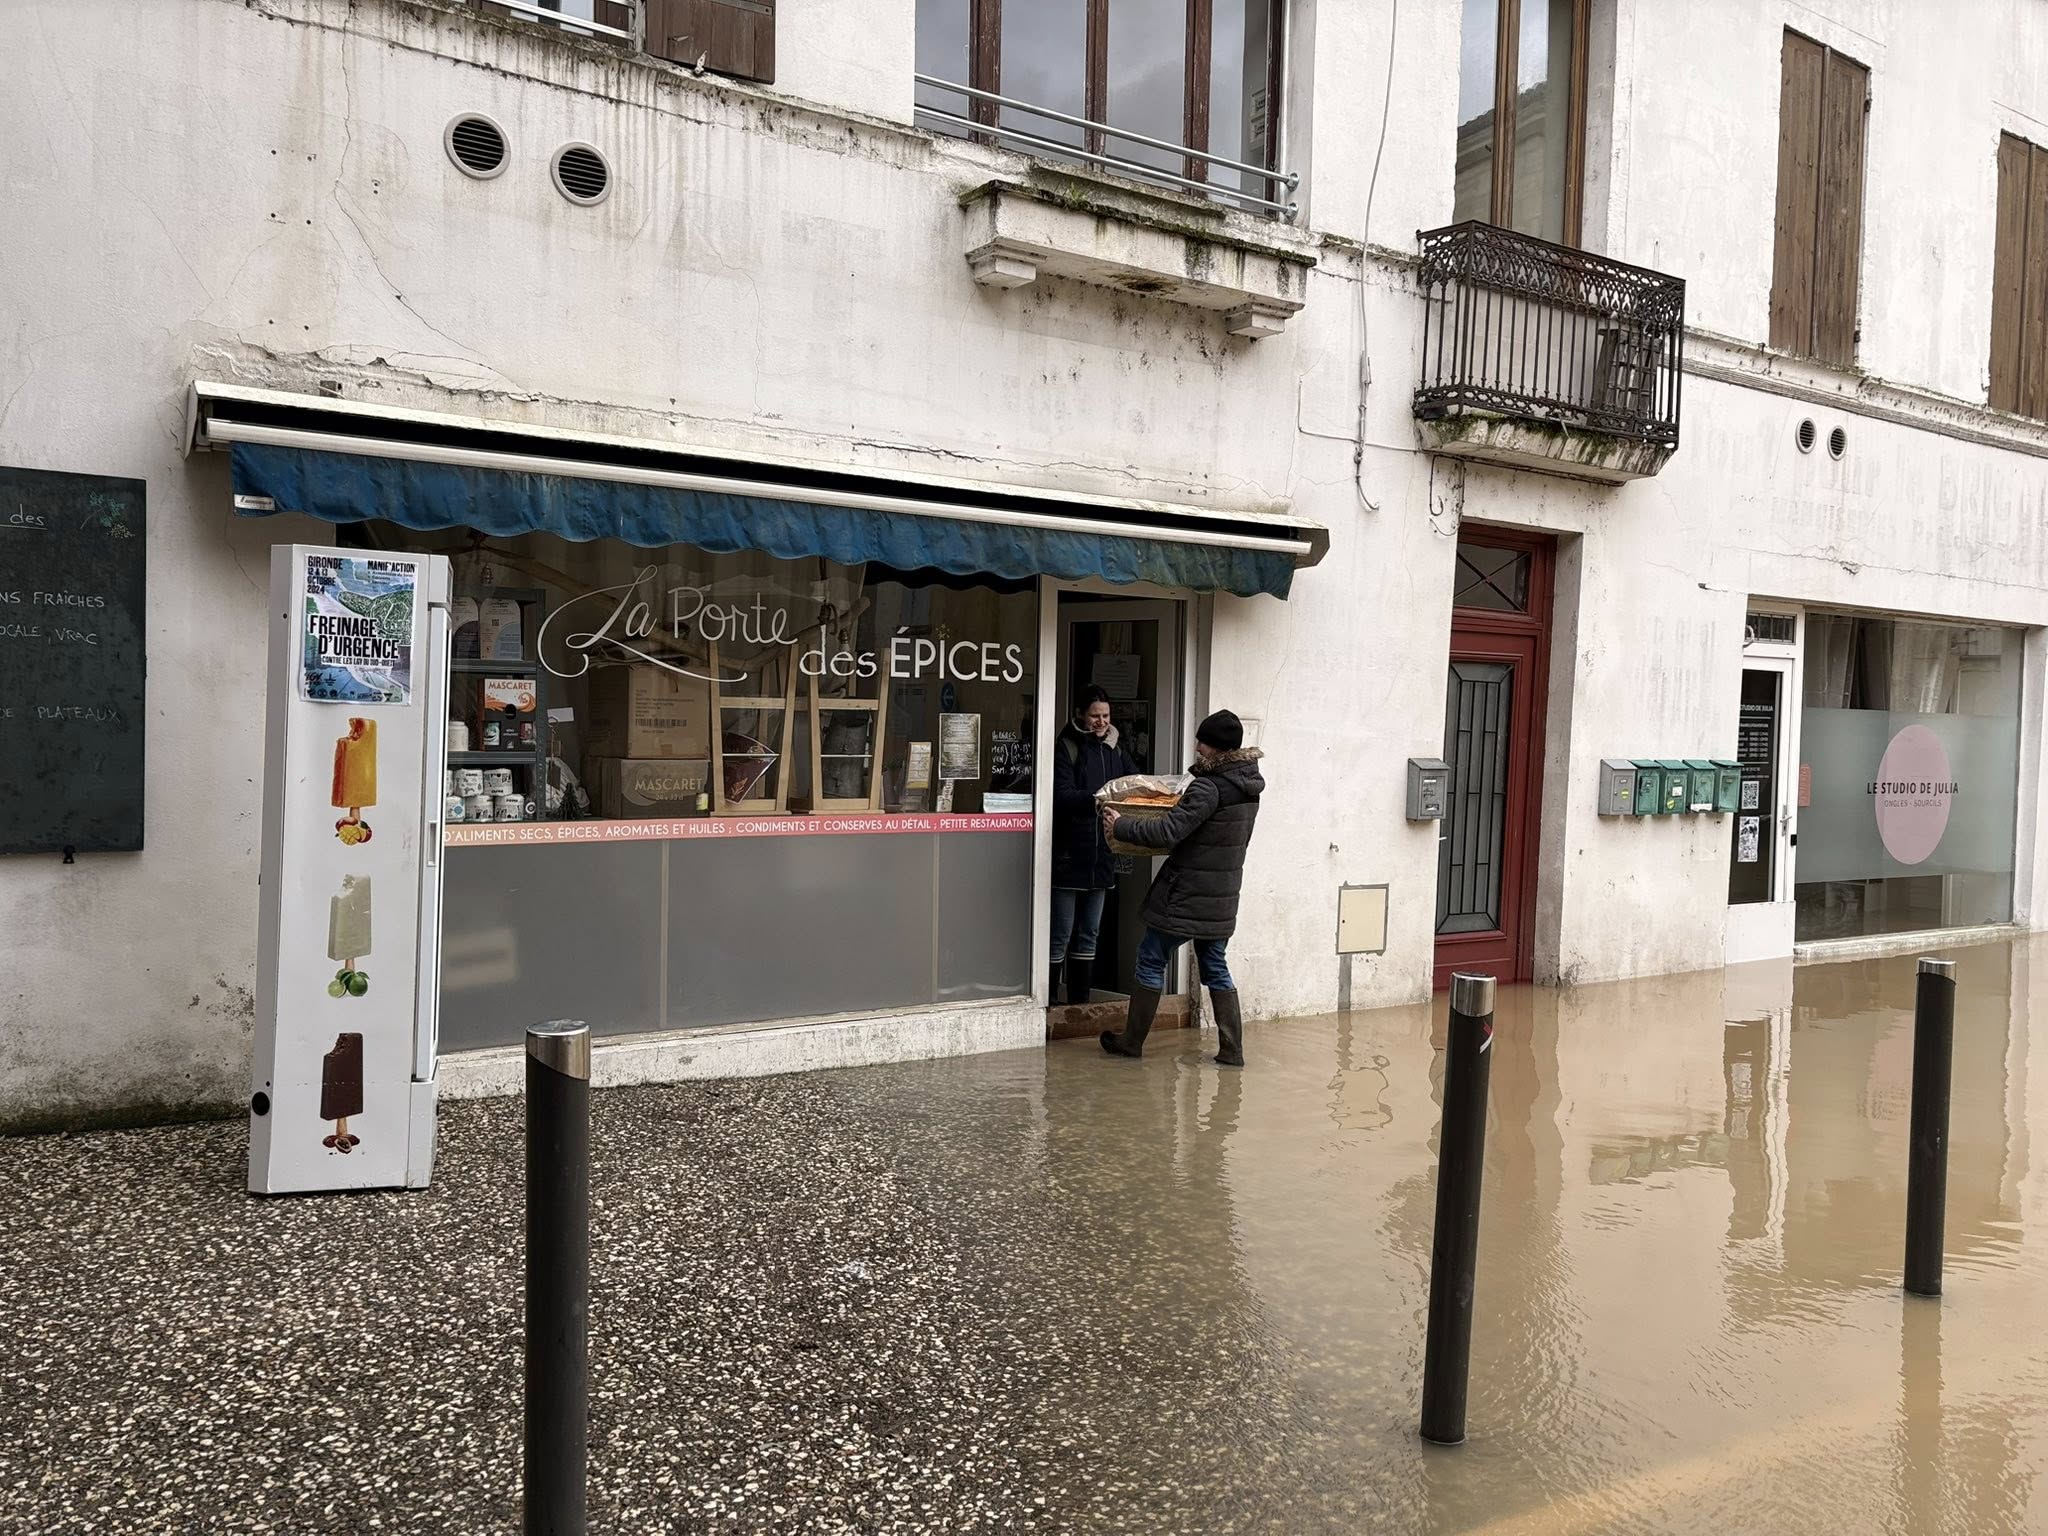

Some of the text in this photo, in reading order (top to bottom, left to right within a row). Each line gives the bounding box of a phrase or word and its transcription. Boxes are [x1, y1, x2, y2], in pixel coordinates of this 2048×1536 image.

[9, 503, 45, 526] des
[307, 555, 344, 570] GIRONDE
[367, 559, 416, 574] MANIF'ACTION
[307, 575, 336, 587] OCTOBRE
[307, 584, 325, 594] 2024
[33, 590, 105, 608] FRAÎCHES
[667, 587, 798, 643] Porte
[310, 614, 377, 637] FREINAGE
[318, 635, 400, 659] D'URGENCE
[799, 624, 1024, 683] des ÉPICES
[322, 656, 342, 665] CONTRE
[342, 657, 352, 665] LES
[488, 681, 533, 690] MASCARET
[37, 705, 121, 722] PLATEAUX
[634, 778, 703, 791] MASCARET
[1866, 782, 1959, 796] LE STUDIO DE JULIA
[1883, 800, 1908, 808] ONGLES
[1913, 799, 1942, 808] SOURCILS
[519, 827, 554, 841] SECS,
[557, 825, 602, 840] ÉPICES,
[605, 823, 669, 837] AROMATES
[672, 822, 686, 834] ET
[689, 822, 725, 834] HUILES
[736, 821, 806, 833] CONDIMENTS
[809, 820, 821, 831] ET
[824, 819, 883, 831] CONSERVES
[885, 819, 898, 830] AU
[901, 817, 931, 830] DÉTAIL
[940, 818, 968, 829] PETITE
[970, 818, 1033, 829] RESTAURATION
